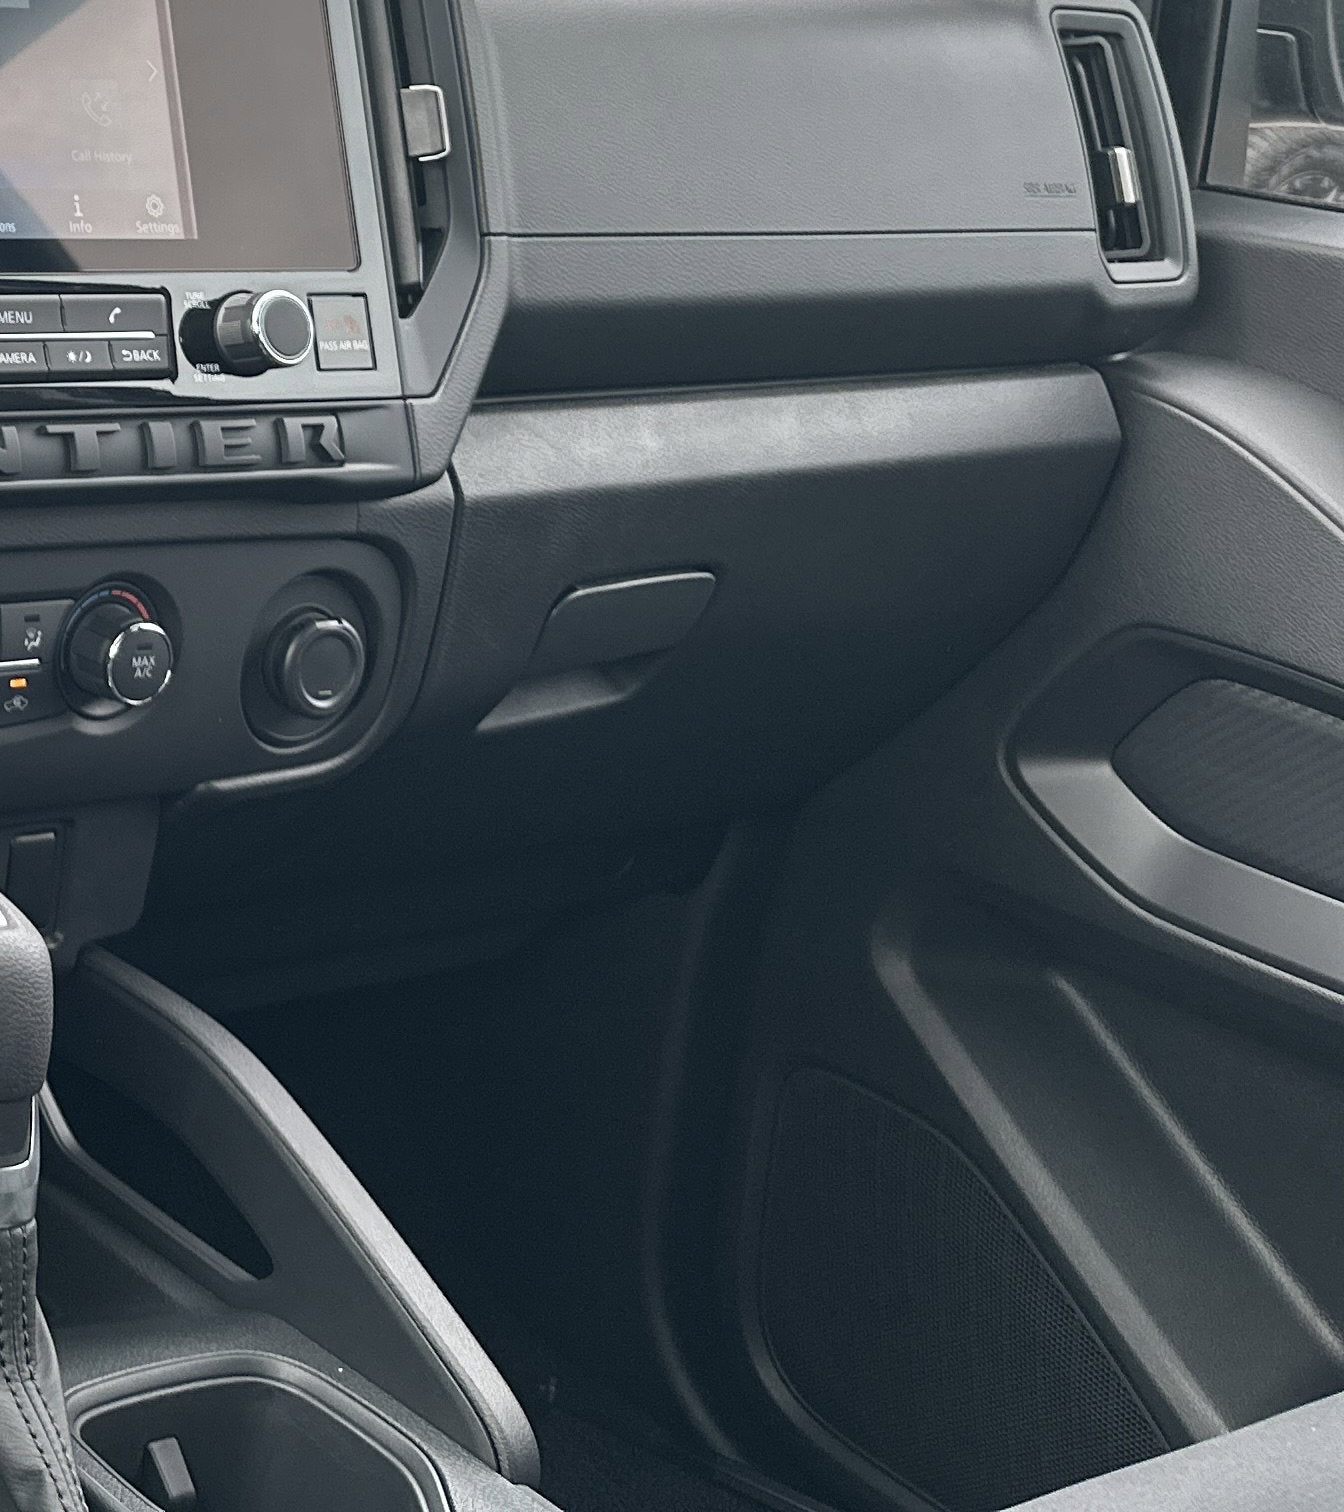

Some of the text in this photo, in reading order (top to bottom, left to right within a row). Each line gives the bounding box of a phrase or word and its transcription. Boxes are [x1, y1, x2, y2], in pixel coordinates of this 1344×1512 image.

[69, 218, 92, 234] Info
[135, 219, 180, 236] Settings
[132, 349, 161, 363] BACK
[132, 655, 156, 668] MAX
[134, 666, 153, 679] A/C
